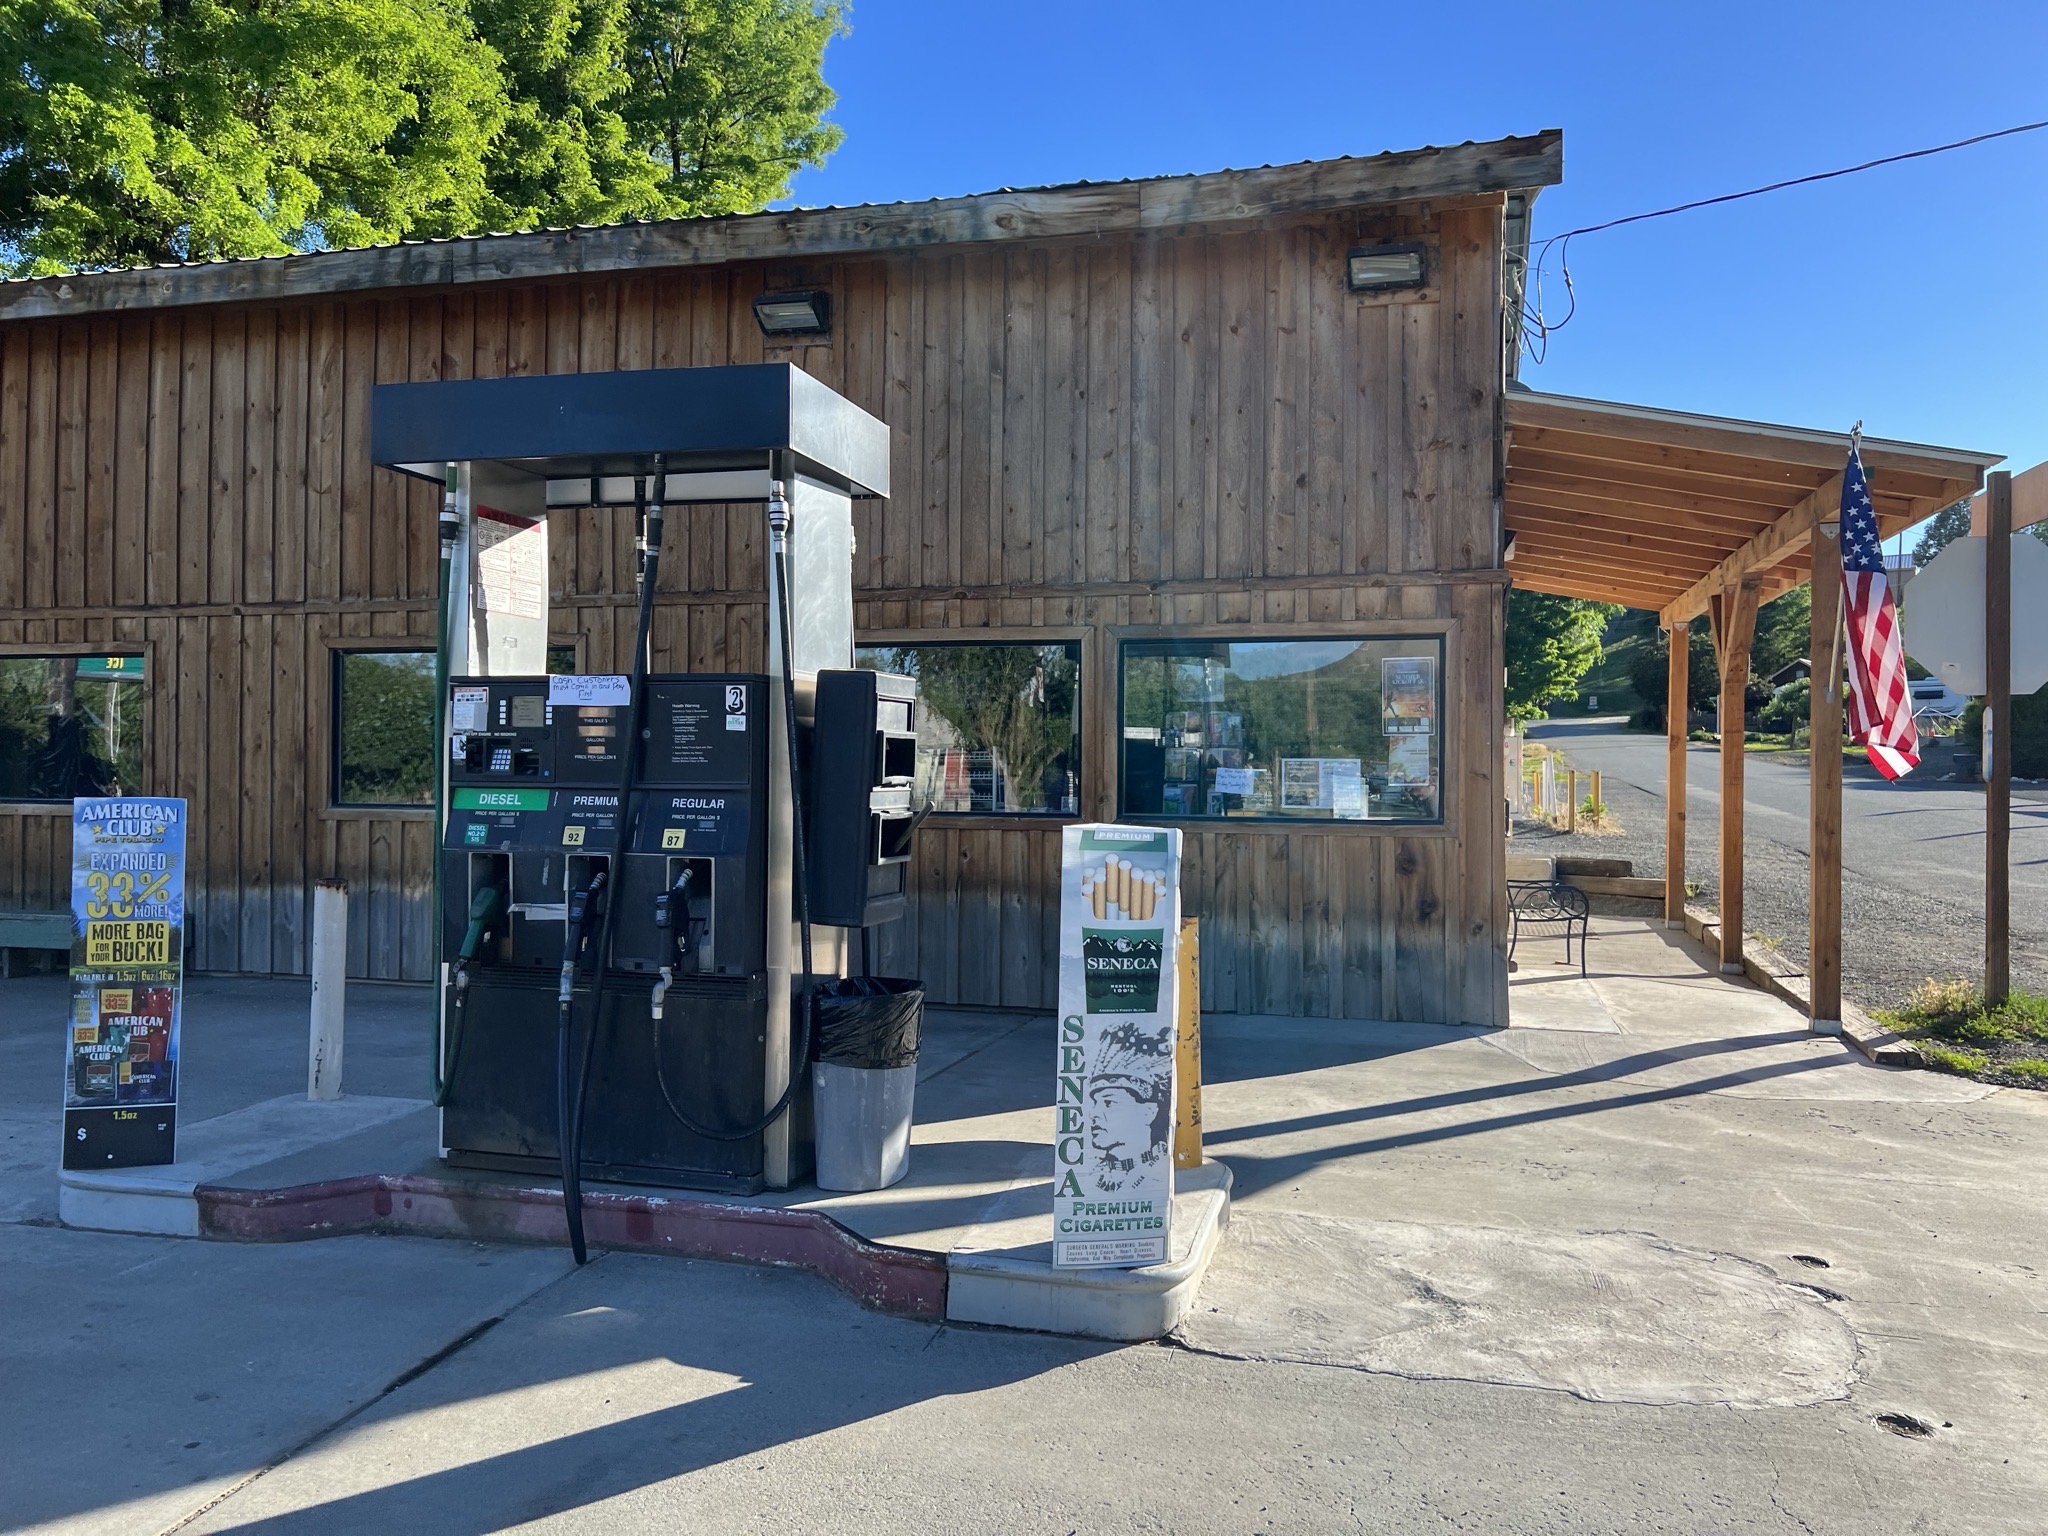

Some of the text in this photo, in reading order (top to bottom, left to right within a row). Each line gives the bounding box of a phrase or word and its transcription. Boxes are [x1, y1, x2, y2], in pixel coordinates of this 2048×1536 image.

[479, 794, 521, 805] DIESEL
[672, 798, 725, 809] REGULAR
[82, 803, 178, 823] AMERICAN
[106, 820, 153, 836] CLUB
[568, 833, 580, 842] 92
[667, 836, 680, 846] 87
[1098, 831, 1150, 840] PREMIUM
[90, 852, 167, 871] EXPANDED
[87, 872, 172, 919] 33%
[134, 904, 168, 918] MORE!
[92, 923, 164, 940] MORE BAG
[96, 943, 109, 952] FOR
[112, 941, 163, 962] BUCK!
[91, 952, 110, 962] YOUR
[1087, 957, 1158, 970] SENECA
[116, 971, 136, 981] 1.5oz
[108, 1016, 163, 1027] AMERICAN
[79, 1044, 123, 1054] AMERICAN
[1054, 1014, 1087, 1198] SENECA
[113, 1111, 137, 1120] 1.5oz
[77, 1127, 86, 1141] $
[1072, 1200, 1152, 1216] PREMIUM
[1060, 1216, 1164, 1233] CIGARETTES
